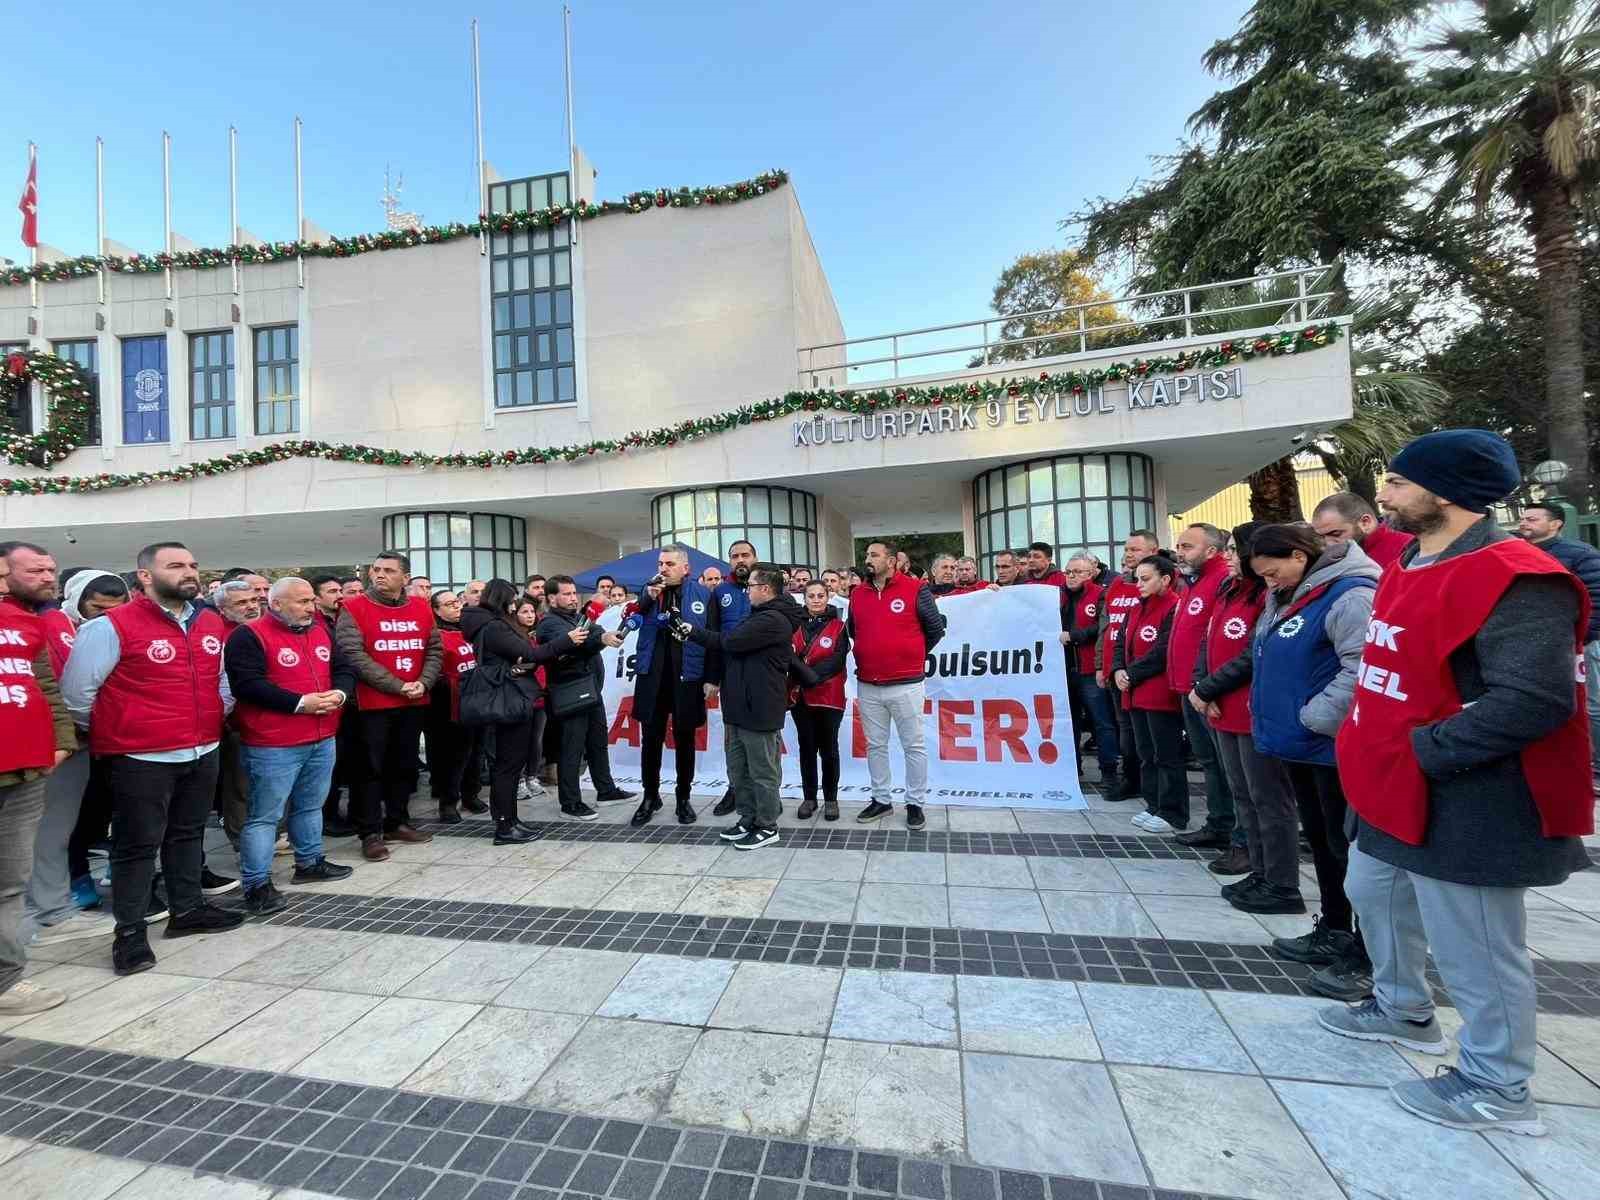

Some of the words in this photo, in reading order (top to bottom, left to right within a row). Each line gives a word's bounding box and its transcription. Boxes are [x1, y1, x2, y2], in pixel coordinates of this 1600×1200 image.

[986, 394, 1002, 427] 9
[1127, 367, 1243, 410] KAPISI
[380, 618, 420, 632] DİSK
[373, 638, 425, 651] GENEL
[395, 656, 413, 672] İŞ
